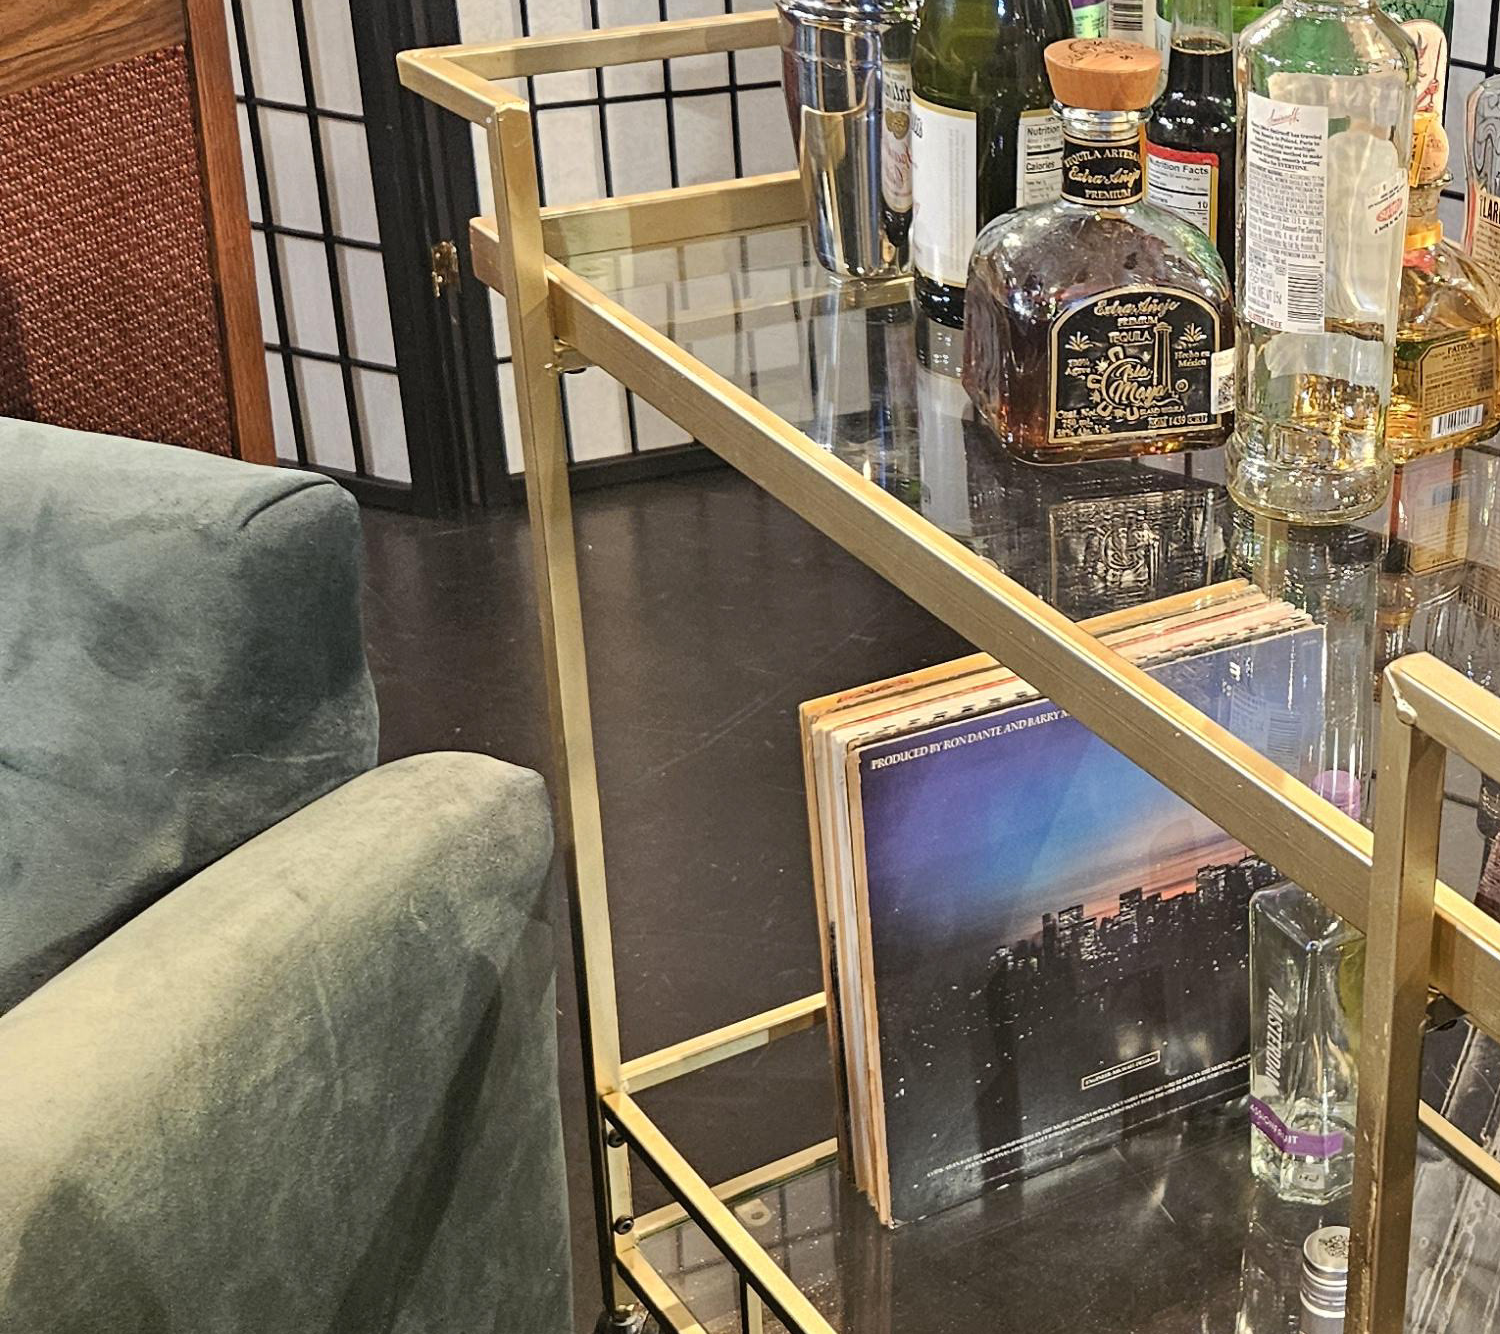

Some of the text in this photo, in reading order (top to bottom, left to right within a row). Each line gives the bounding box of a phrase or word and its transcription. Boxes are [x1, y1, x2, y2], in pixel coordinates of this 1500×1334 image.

[1026, 125, 1060, 137] Nutrition
[1025, 159, 1056, 172] Calories
[1182, 164, 1209, 175] Facts
[1085, 188, 1132, 200] PREMIUM
[1197, 200, 1209, 209] 10
[1093, 298, 1136, 317] Extra
[1117, 316, 1158, 327] PREMIUM
[1266, 318, 1283, 329] FREE
[1107, 329, 1153, 344] TEQUILA
[1174, 350, 1200, 361] Hecho
[1177, 356, 1207, 368] México
[1107, 379, 1169, 408] Maya
[871, 745, 929, 771] PRODUCED
[929, 742, 944, 755] BY
[943, 734, 968, 751] RON
[967, 725, 1003, 743] DANTE
[1004, 718, 1028, 735] AND
[1027, 711, 1062, 728] BARRY
